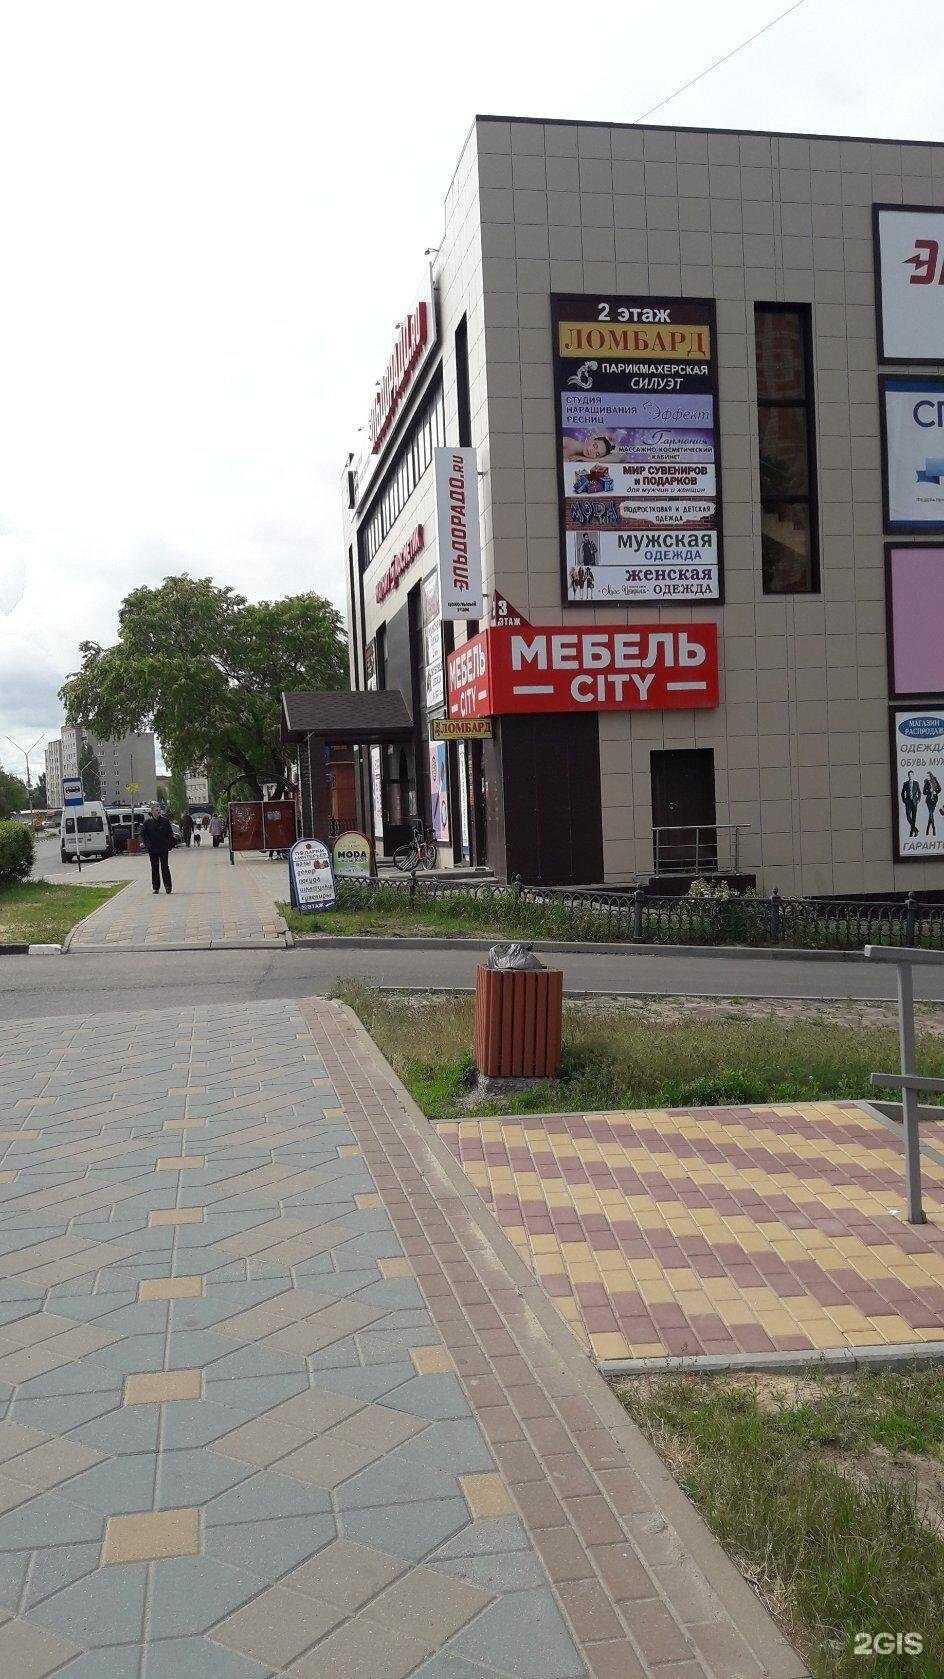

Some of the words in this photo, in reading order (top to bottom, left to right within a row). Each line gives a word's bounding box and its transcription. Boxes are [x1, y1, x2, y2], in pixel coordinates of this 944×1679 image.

[598, 303, 611, 321] 2
[617, 307, 671, 323] этаж
[565, 328, 706, 356] ЛОМБАРД
[601, 363, 708, 375] ПАРИКМАХЕРСКАЯ
[630, 377, 683, 390] СИЛУЭТ
[566, 396, 602, 404] СТУДИЯ
[566, 406, 637, 415] НАРАЩИВАНИЯ
[566, 416, 605, 425] РЕСНИЦ
[618, 446, 713, 454] МАССАЖНО-КОСМЕТИЧЕСКИЙ
[622, 465, 645, 476] МИР
[648, 466, 708, 476] СУВЕНИРОВ
[642, 476, 697, 487] ПОДАРКОВ
[617, 533, 712, 552] мужская
[644, 550, 702, 562] ОДЕЖДА
[625, 568, 713, 581] женская
[653, 584, 713, 596] ОДЕЖДА
[498, 600, 508, 616] 3
[497, 617, 520, 626] ЭТАЖ
[511, 632, 707, 670] МЕБЕЛЬ
[449, 642, 486, 692] МЕБЕЛЬ
[570, 673, 656, 703] CITY
[460, 685, 477, 717] CITY
[440, 721, 491, 734] ЛОМБАРД
[909, 719, 940, 727] МАГАЗИН
[900, 758, 927, 767] ОБУВЬ
